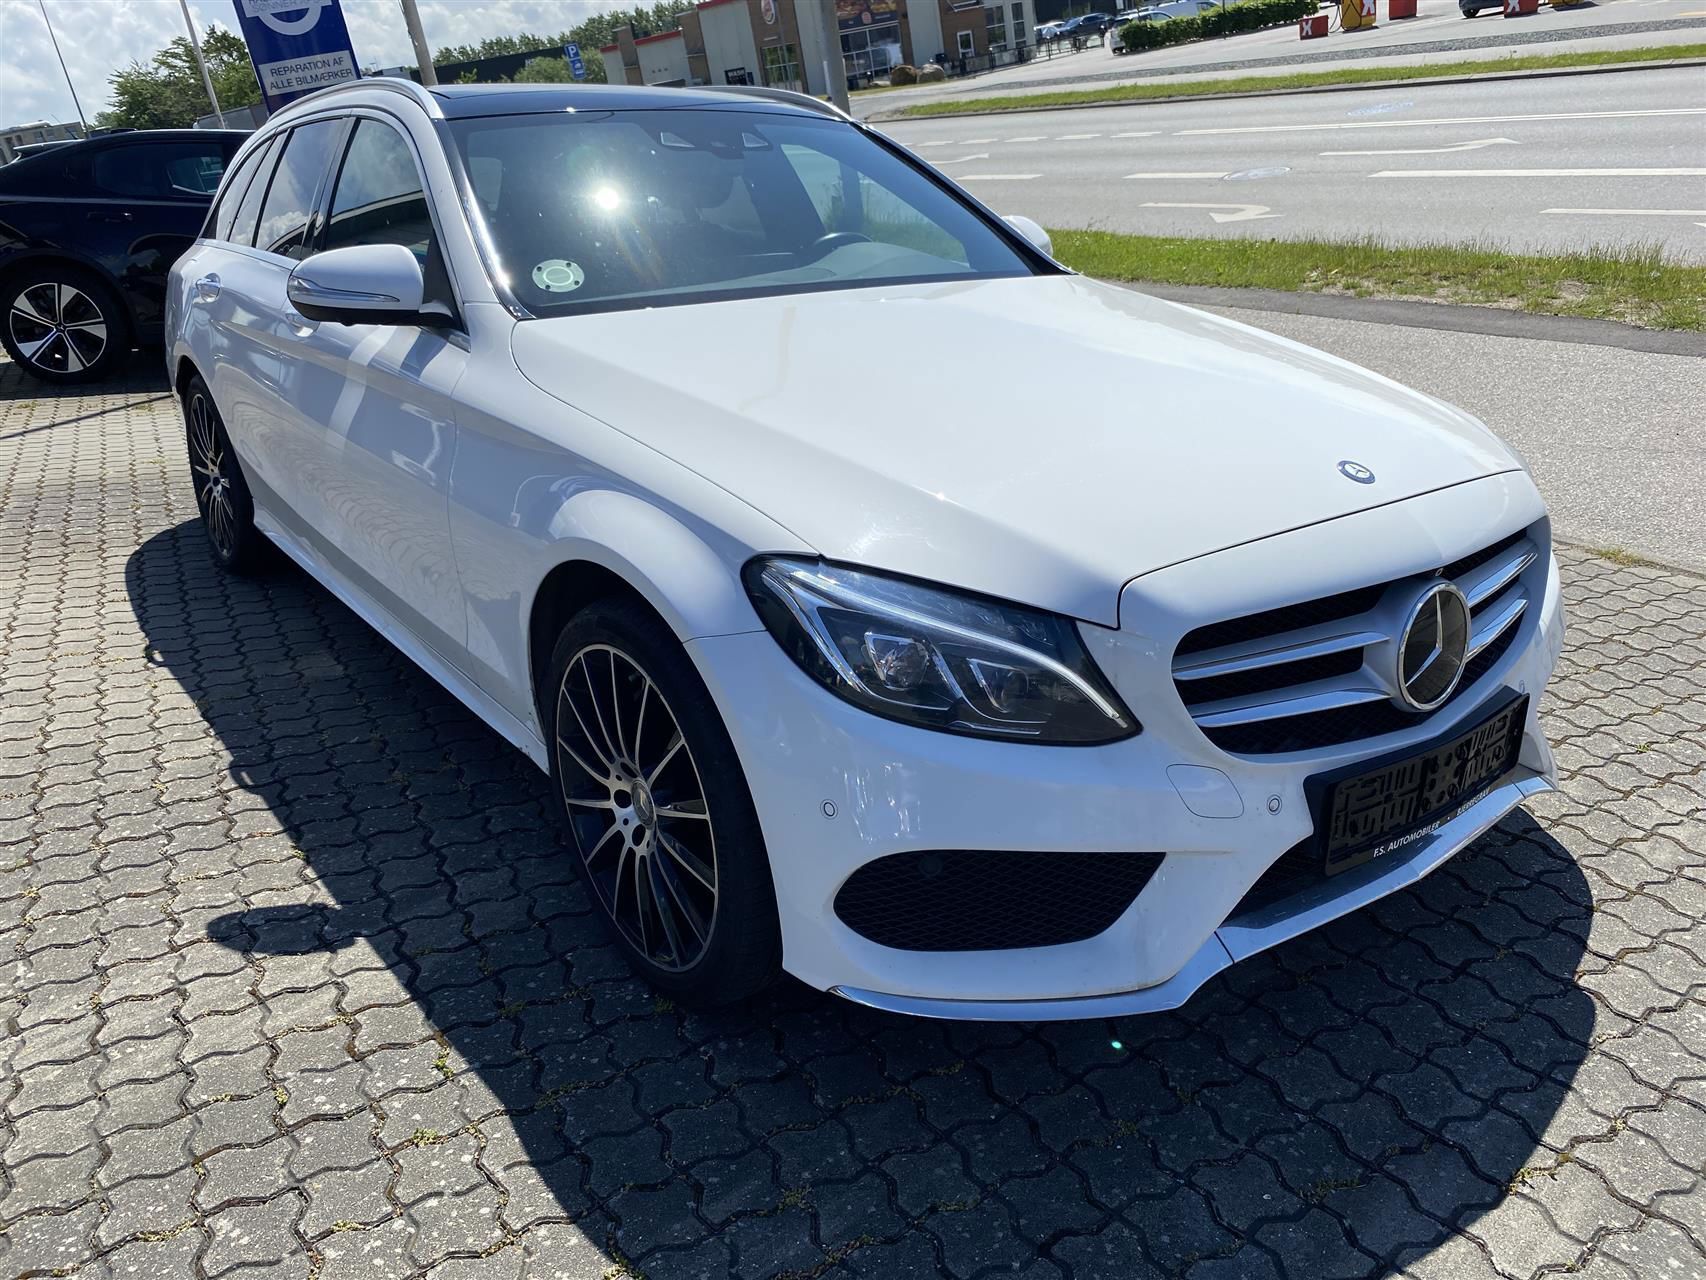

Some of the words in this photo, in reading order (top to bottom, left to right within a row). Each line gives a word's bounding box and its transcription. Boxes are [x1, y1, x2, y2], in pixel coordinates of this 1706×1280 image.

[568, 45, 577, 58] P
[270, 59, 331, 78] REPARATION
[333, 56, 345, 67] AF
[270, 78, 294, 91] ALLE
[296, 68, 354, 87] BILMÆRKER
[1387, 821, 1441, 852] AUTOMOBILER
